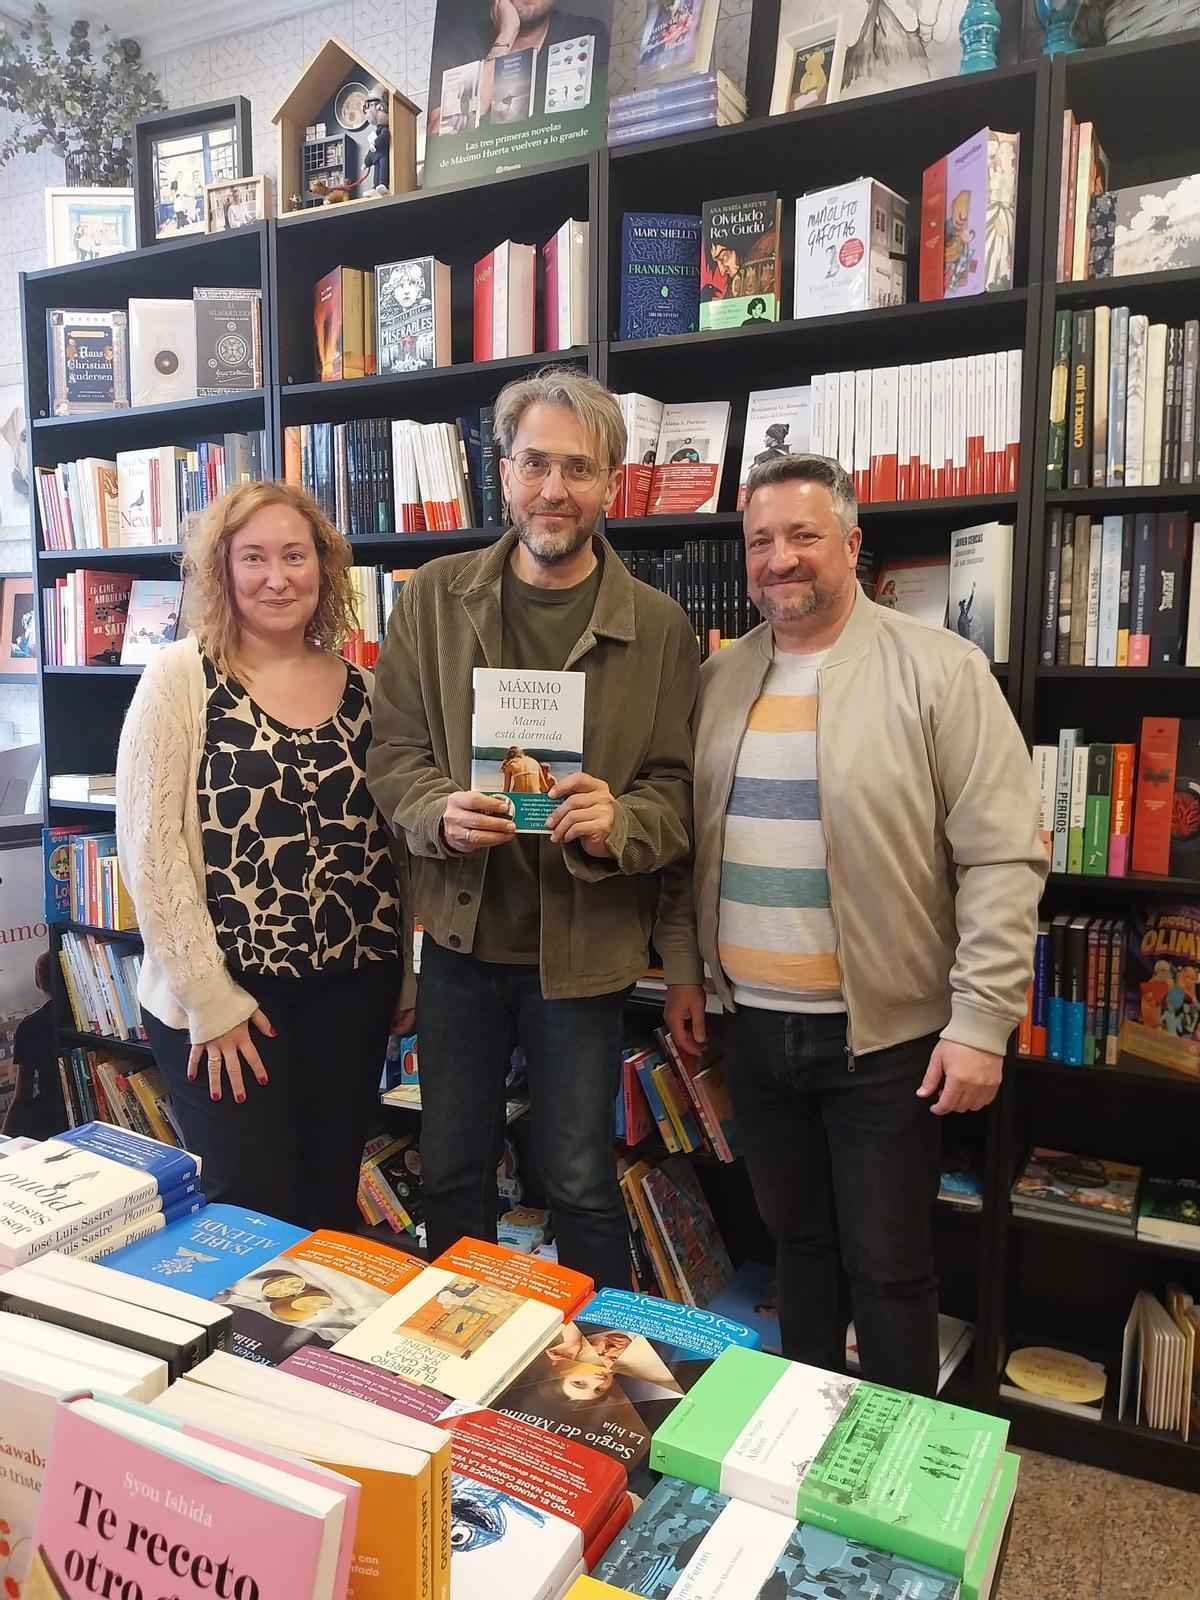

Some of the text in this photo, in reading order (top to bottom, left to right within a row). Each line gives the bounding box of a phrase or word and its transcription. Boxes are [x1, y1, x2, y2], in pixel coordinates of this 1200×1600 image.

[465, 122, 562, 151] Las tres primeras novelas
[440, 158, 449, 168] de
[450, 152, 482, 166] Máximo
[483, 145, 510, 159] Huerta
[511, 138, 542, 152] vuelven
[550, 134, 558, 144] lo
[559, 128, 589, 144] grande
[503, 163, 522, 172] Planeta
[710, 200, 768, 214] ANA MARÍA MATUTE
[808, 200, 858, 229] MANOLITO
[712, 209, 763, 226] Olvidado
[633, 228, 699, 240] MARY SHELLEY
[710, 221, 765, 240] Rey Gudú
[807, 220, 856, 256] GAFOTAS
[628, 264, 700, 276] FRANKENSTEIN
[381, 317, 432, 346] MISERABLES
[79, 346, 103, 358] Hans
[67, 359, 112, 371] Christian
[68, 371, 113, 384] Andersen
[1074, 364, 1087, 448] CATORCE DE JULIO
[121, 511, 150, 529] Nexu
[954, 533, 984, 548] JAVIER CERCAS
[90, 583, 115, 594] EL CINE
[94, 591, 131, 605] AMBULANT
[1088, 602, 1097, 617] JEFE
[93, 623, 125, 636] MR. SAIT
[498, 678, 562, 694] MÁXIMO
[500, 697, 559, 711] HUERTA
[511, 716, 546, 727] Mamá
[494, 729, 562, 741] está dormida
[1056, 792, 1068, 834] PERROS
[1, 1197, 51, 1226] Sastre
[28, 1186, 155, 1257] José Luis Sastre Plomo
[56, 1202, 154, 1255] uis Sastre Plomo
[125, 1223, 157, 1247] Plomo
[192, 1217, 280, 1248] ALLENDE
[189, 1229, 255, 1257] ISABEL
[393, 1344, 441, 1365] RACHID
[398, 1338, 449, 1360] BENZINE
[369, 1354, 437, 1383] EL LIBRERO
[384, 1350, 437, 1374] DE GAZA
[327, 1381, 364, 1397] ESCRITURA
[498, 1408, 635, 1460] Sergio del Molino
[602, 1421, 645, 1446] La hija
[0, 1437, 46, 1468] awab
[467, 1457, 480, 1467] LA
[470, 1448, 487, 1460] Juan
[479, 1463, 515, 1482] CONOCE
[496, 1460, 528, 1477] divertida
[10, 1469, 43, 1492] triste
[455, 1461, 575, 1515] TODO EL MUNDO CONOCE SU
[515, 1478, 543, 1493] NADIE
[528, 1474, 543, 1483] más
[543, 1479, 568, 1493] novela
[123, 1471, 214, 1528] Syou Ishida
[543, 1490, 568, 1504] PERO
[440, 1467, 449, 1570] LANA CORUJO
[74, 1480, 260, 1598] Te receto
[358, 1555, 379, 1564] con
[421, 1535, 429, 1598] CORUJO
[687, 1548, 711, 1582] Ferrari
[64, 1548, 143, 1600] otro
